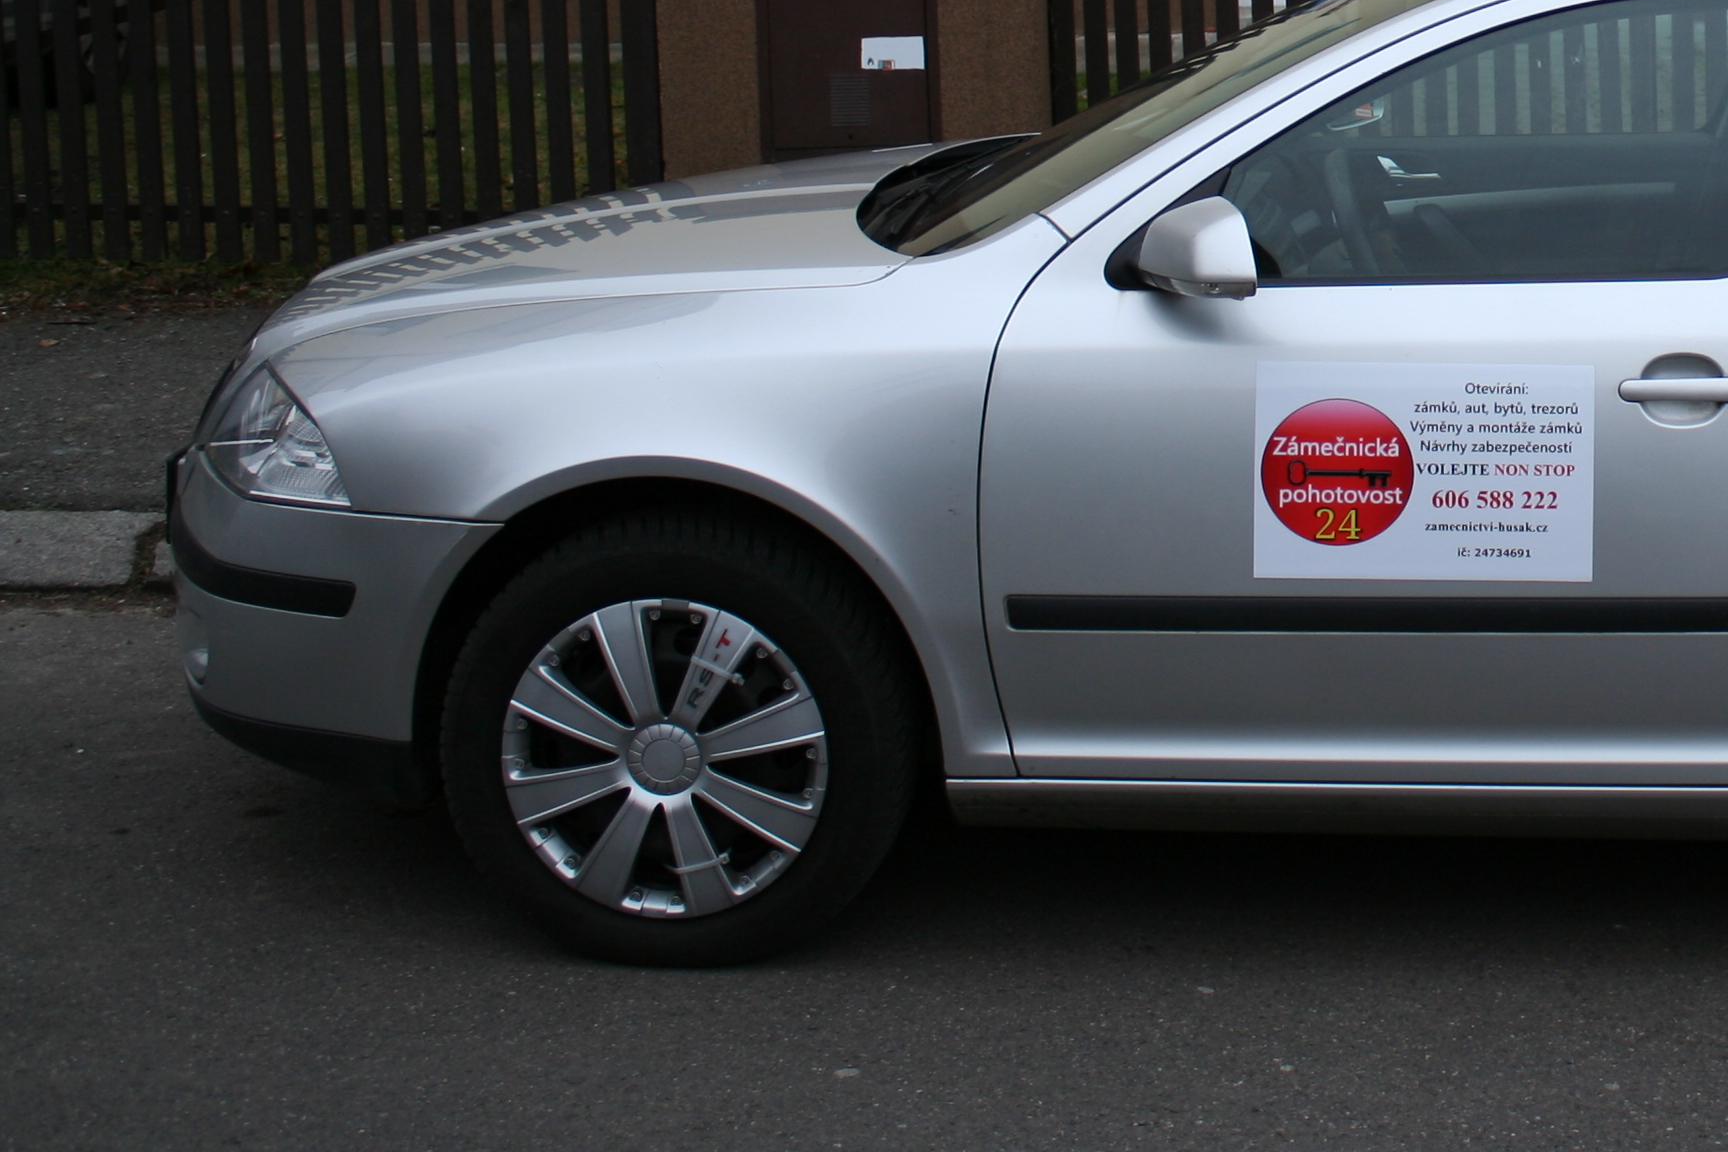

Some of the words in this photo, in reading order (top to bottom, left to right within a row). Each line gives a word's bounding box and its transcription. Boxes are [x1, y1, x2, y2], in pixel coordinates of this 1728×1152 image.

[1465, 382, 1530, 395] Otevírání:
[1414, 400, 1460, 415] zámků,
[1465, 402, 1489, 415] aut,
[1494, 401, 1526, 417] bytů,
[1531, 402, 1578, 414] trezorů
[1410, 419, 1462, 435] Výměny
[1467, 424, 1475, 433] a
[1478, 421, 1535, 434] montáže
[1539, 421, 1584, 434] zámků
[1272, 436, 1401, 457] Zámečnická
[1420, 439, 1467, 455] Návrhy
[1415, 463, 1490, 476] VOLEJTE
[1494, 464, 1529, 476] NON
[1534, 464, 1576, 477] STOP
[1279, 483, 1403, 508] pohotovost
[1432, 489, 1470, 509] 606
[1476, 489, 1514, 509] 588
[1521, 490, 1559, 509] 222
[1315, 507, 1362, 541] 24
[1425, 520, 1549, 534] zamecnictvi-husak.cz
[1474, 547, 1532, 559] 24734691
